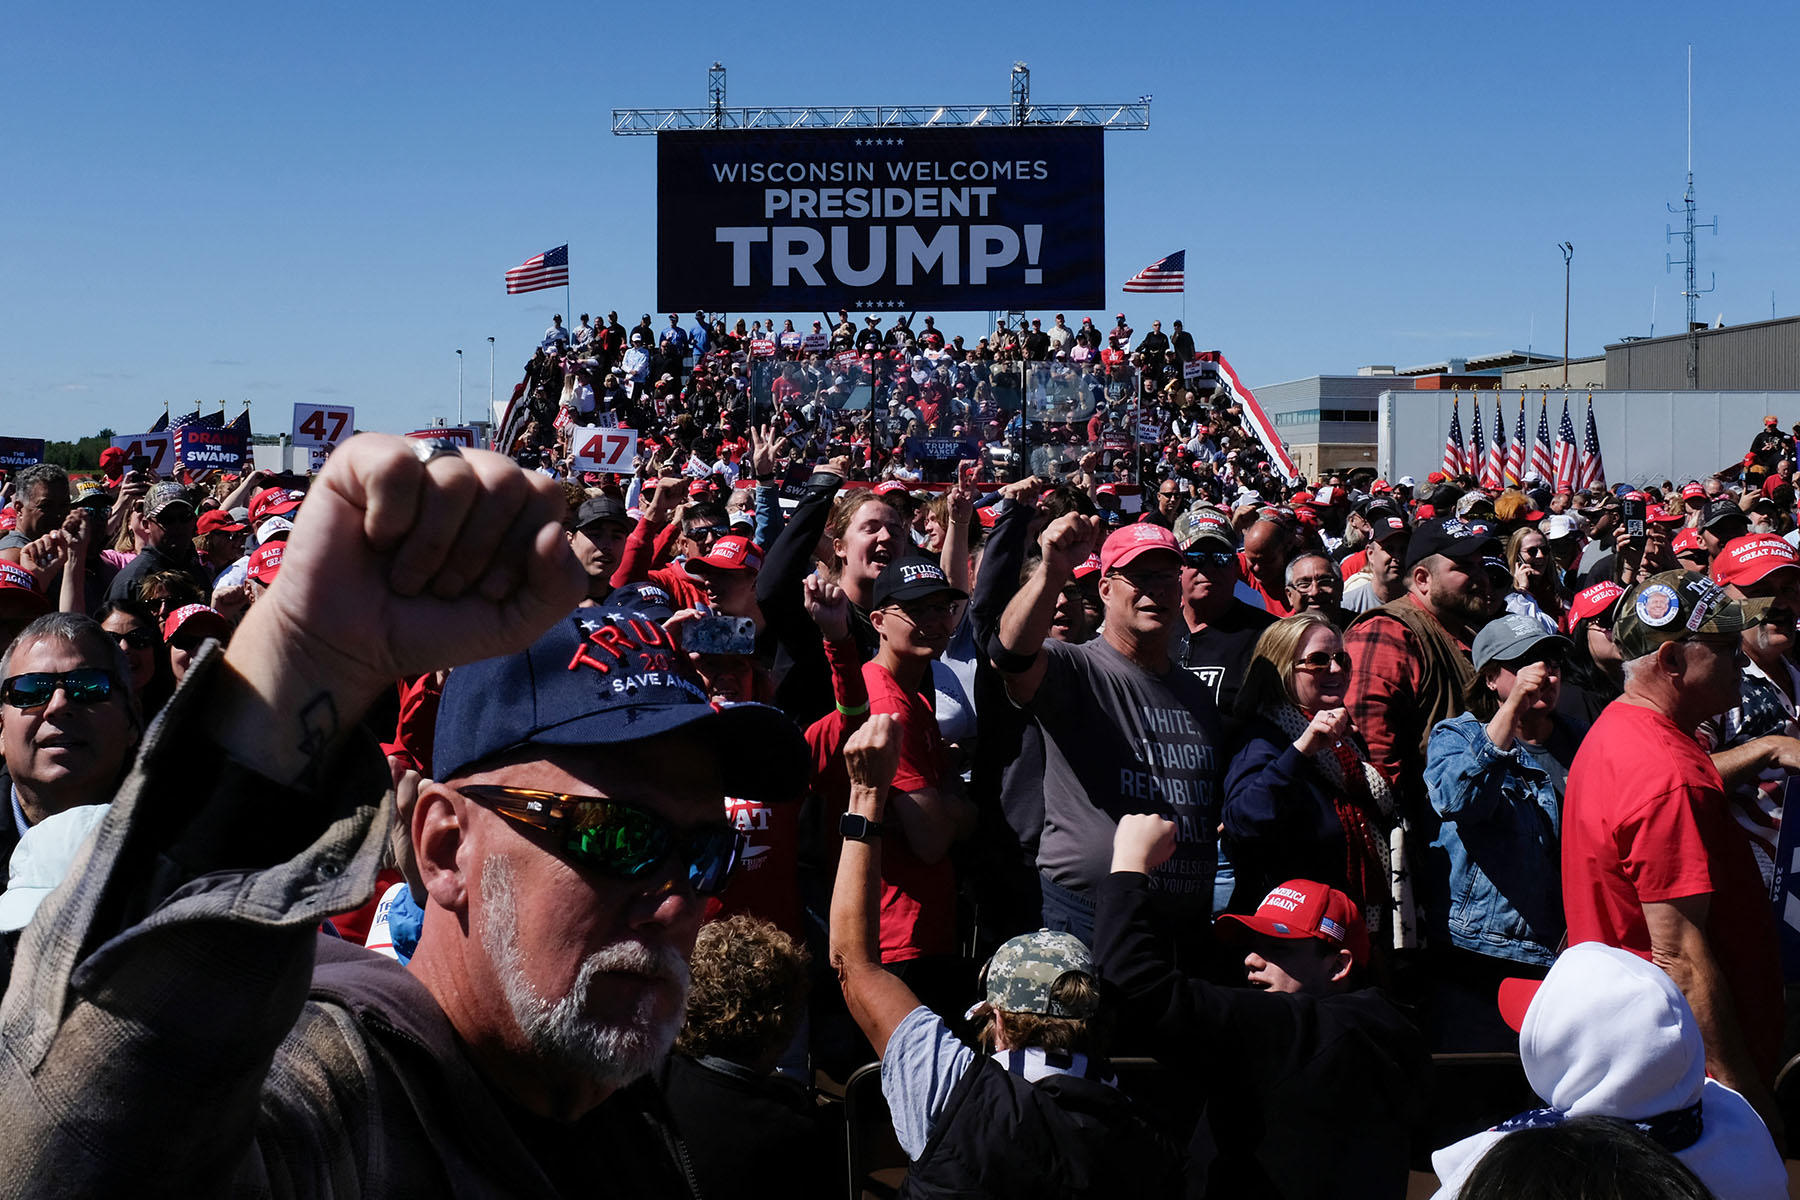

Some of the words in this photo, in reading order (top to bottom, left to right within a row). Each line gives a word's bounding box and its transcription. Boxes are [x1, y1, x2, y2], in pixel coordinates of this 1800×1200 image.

[713, 161, 875, 183] WISCONSIN
[886, 159, 1049, 182] WELCOMES
[765, 186, 997, 219] PRESIDENT
[715, 224, 1043, 288] TRUMP!
[299, 410, 348, 442] 47
[188, 431, 240, 444] DRAIN
[187, 451, 240, 463] SWAMP
[579, 434, 630, 465] 47
[0, 456, 38, 465] SWAMP
[1188, 512, 1225, 524] Trump
[261, 548, 281, 559] MAKE
[1731, 541, 1758, 557] MAKE
[1739, 548, 1769, 563] GREAT
[1770, 548, 1794, 560] AGAIN
[1582, 583, 1605, 599] MAKE
[1591, 589, 1615, 603] GREAT
[568, 619, 676, 673] TRU
[639, 653, 676, 671] 20
[612, 673, 662, 692] SAVE
[1772, 867, 1783, 902] 2024
[1266, 896, 1298, 912] AGAIN
